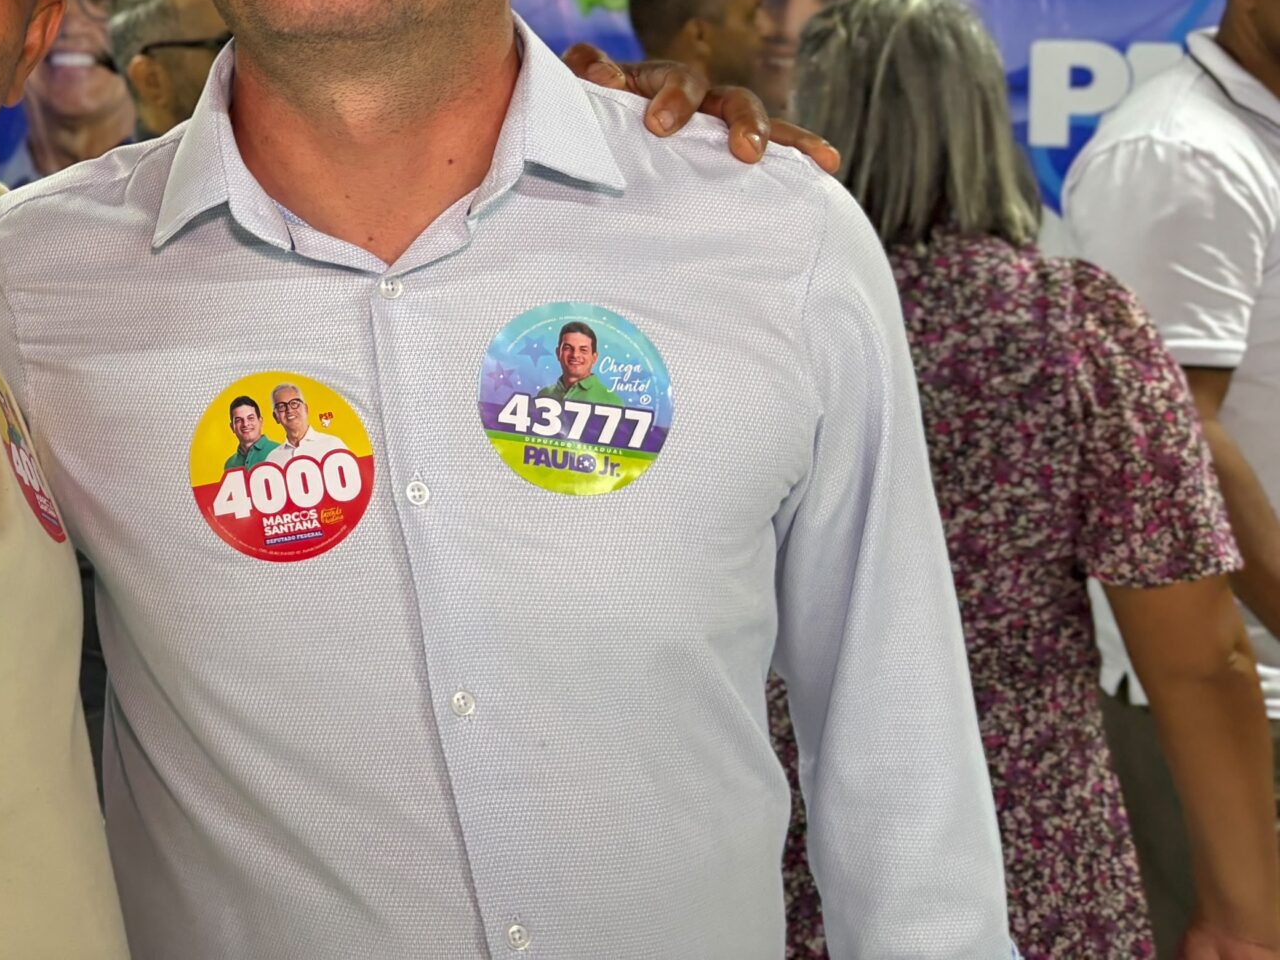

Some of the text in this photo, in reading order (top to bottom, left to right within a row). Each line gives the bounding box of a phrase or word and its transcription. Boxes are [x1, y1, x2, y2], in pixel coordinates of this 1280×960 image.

[599, 356, 642, 381] Chega
[497, 393, 653, 448] 43777
[523, 445, 621, 477] PAULO Jr.
[213, 452, 362, 520] 4000
[262, 509, 318, 526] MARCOS
[264, 520, 321, 536] SANTANA
